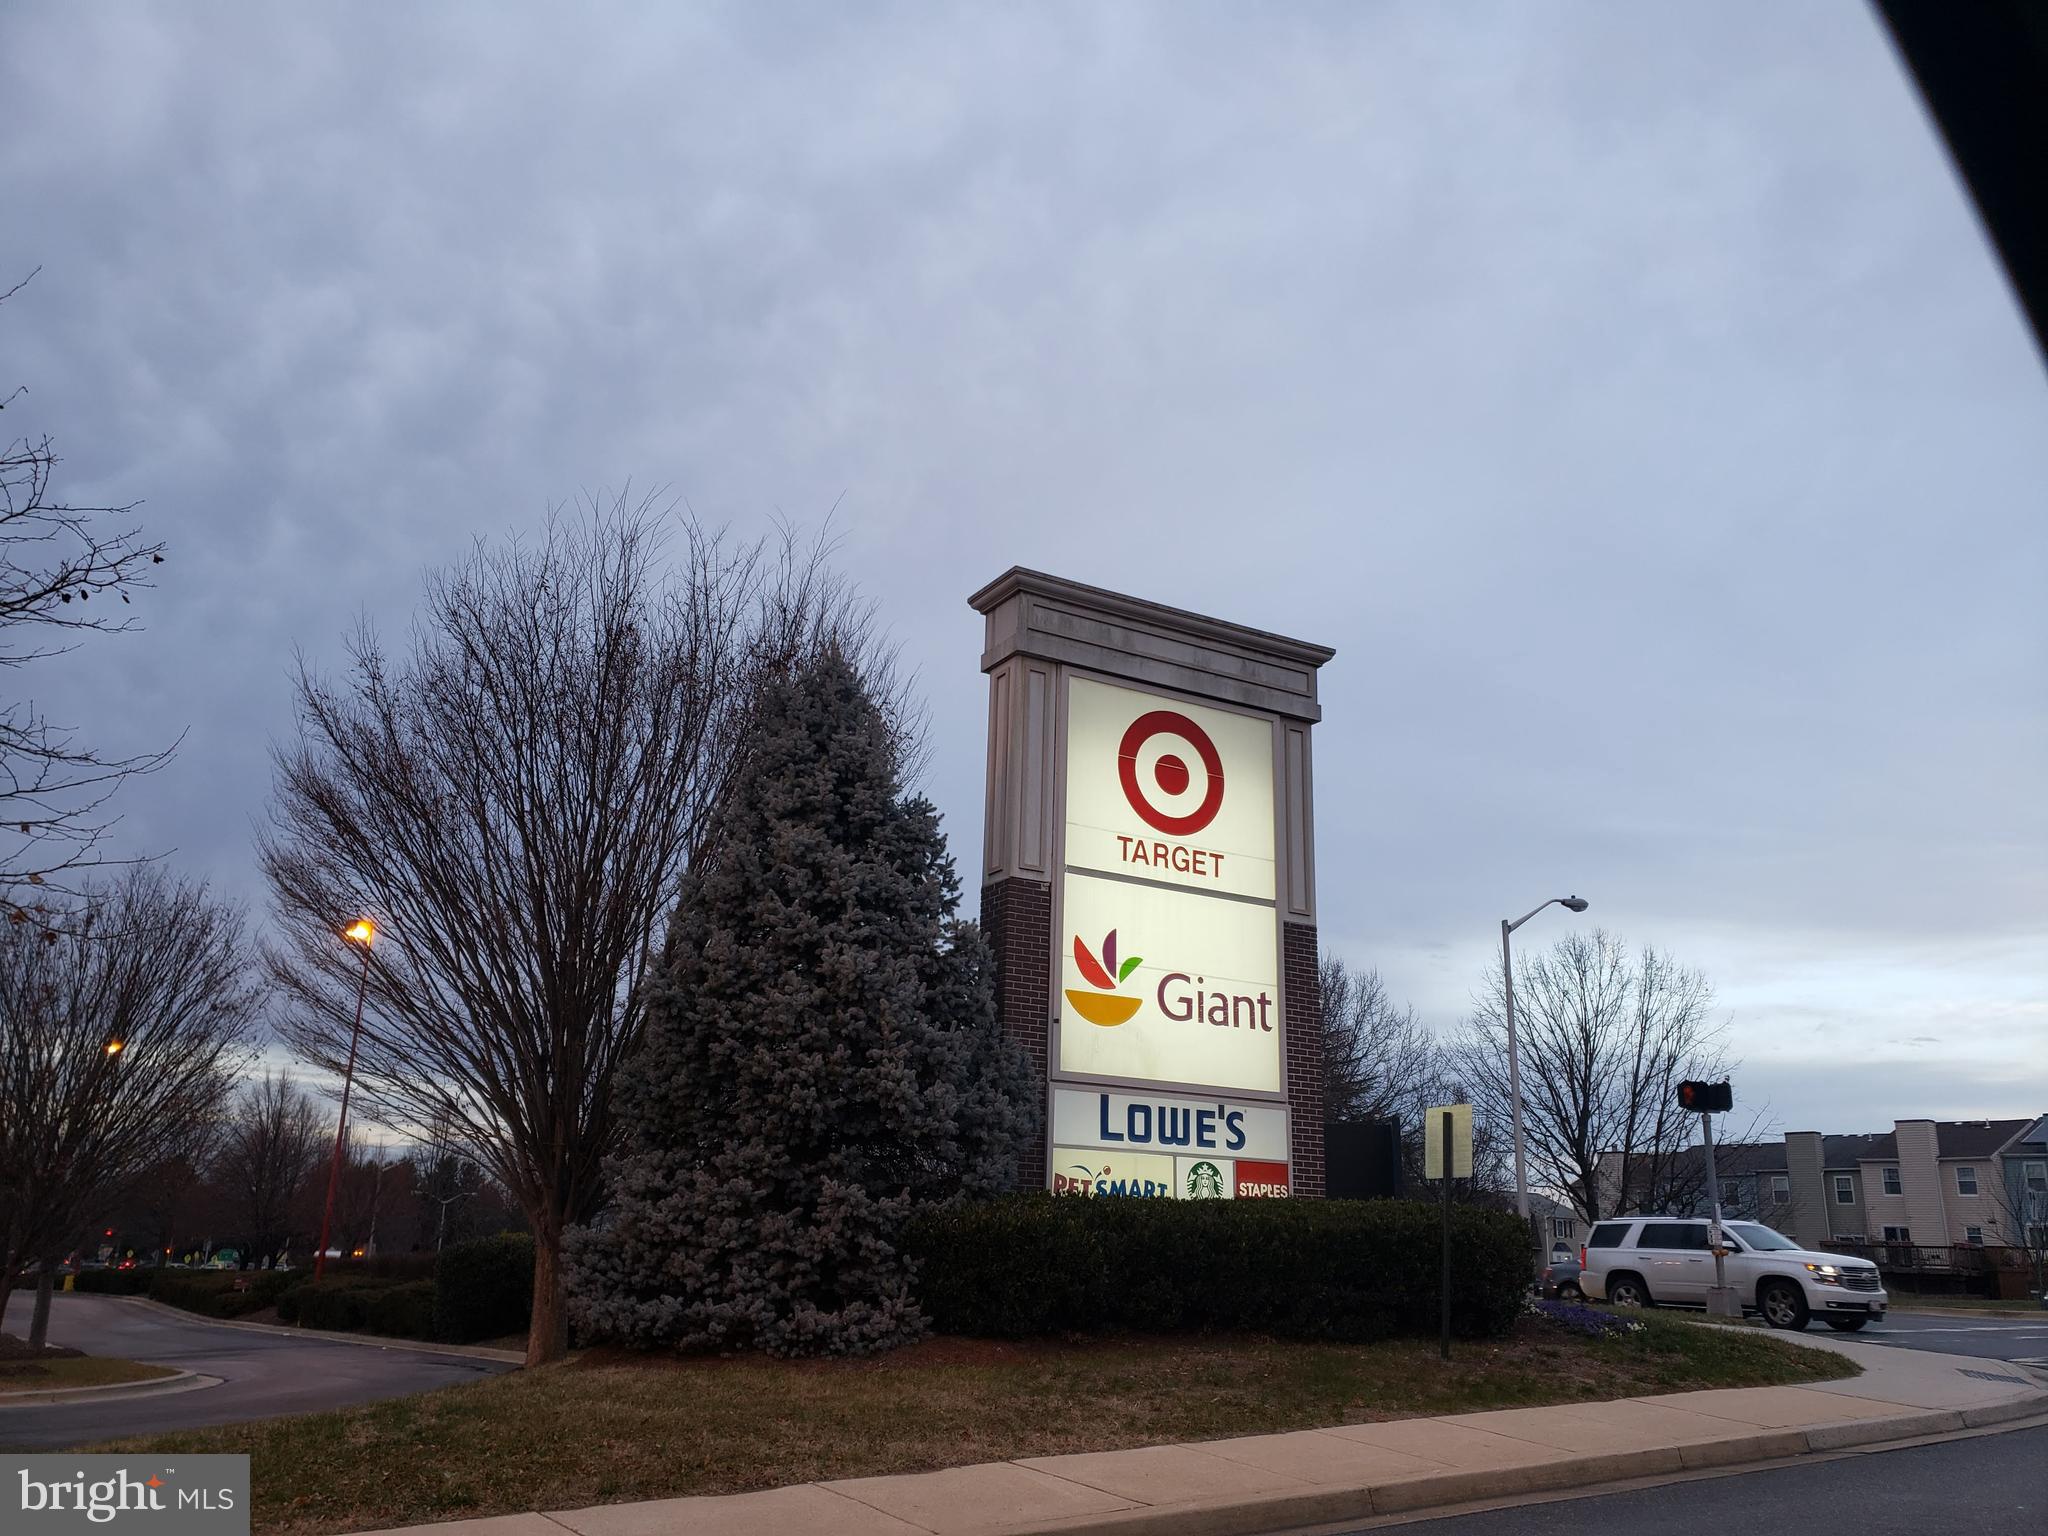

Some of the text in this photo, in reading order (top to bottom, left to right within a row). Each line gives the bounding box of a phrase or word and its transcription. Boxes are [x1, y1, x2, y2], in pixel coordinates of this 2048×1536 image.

[1116, 835, 1225, 878] TARGET
[1157, 972, 1273, 1032] Giant
[1099, 1093, 1246, 1151] LOWE'S
[1239, 1182, 1288, 1199] STAPLES
